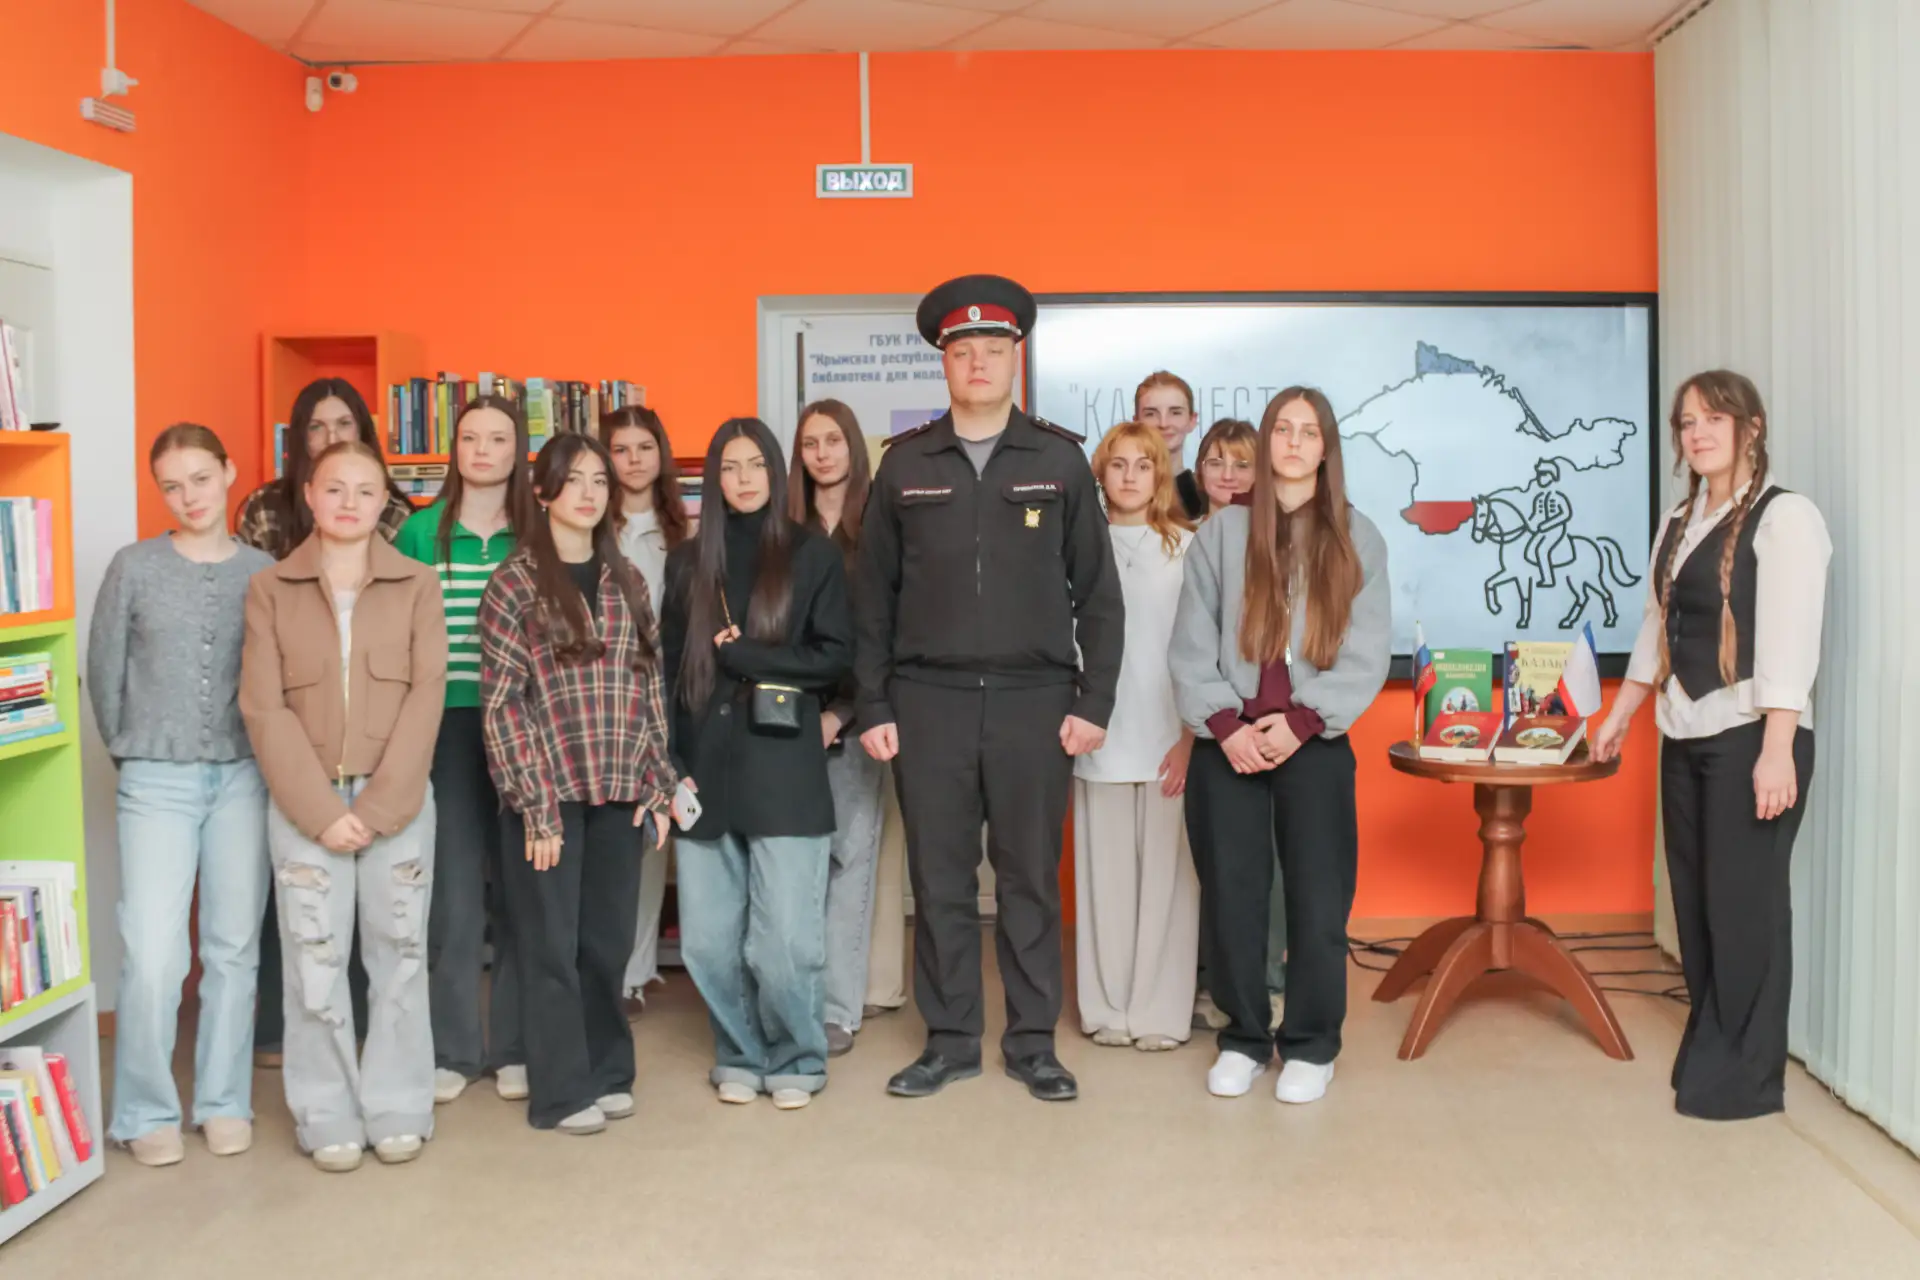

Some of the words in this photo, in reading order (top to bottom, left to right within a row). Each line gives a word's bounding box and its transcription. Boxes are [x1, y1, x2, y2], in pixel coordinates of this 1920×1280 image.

[826, 171, 904, 191] ВЫХОД
[869, 334, 902, 346] ГБУК
[809, 352, 876, 366] "Крымская
[812, 371, 881, 383] библиотека
[886, 371, 908, 382] для
[913, 369, 946, 381] моло
